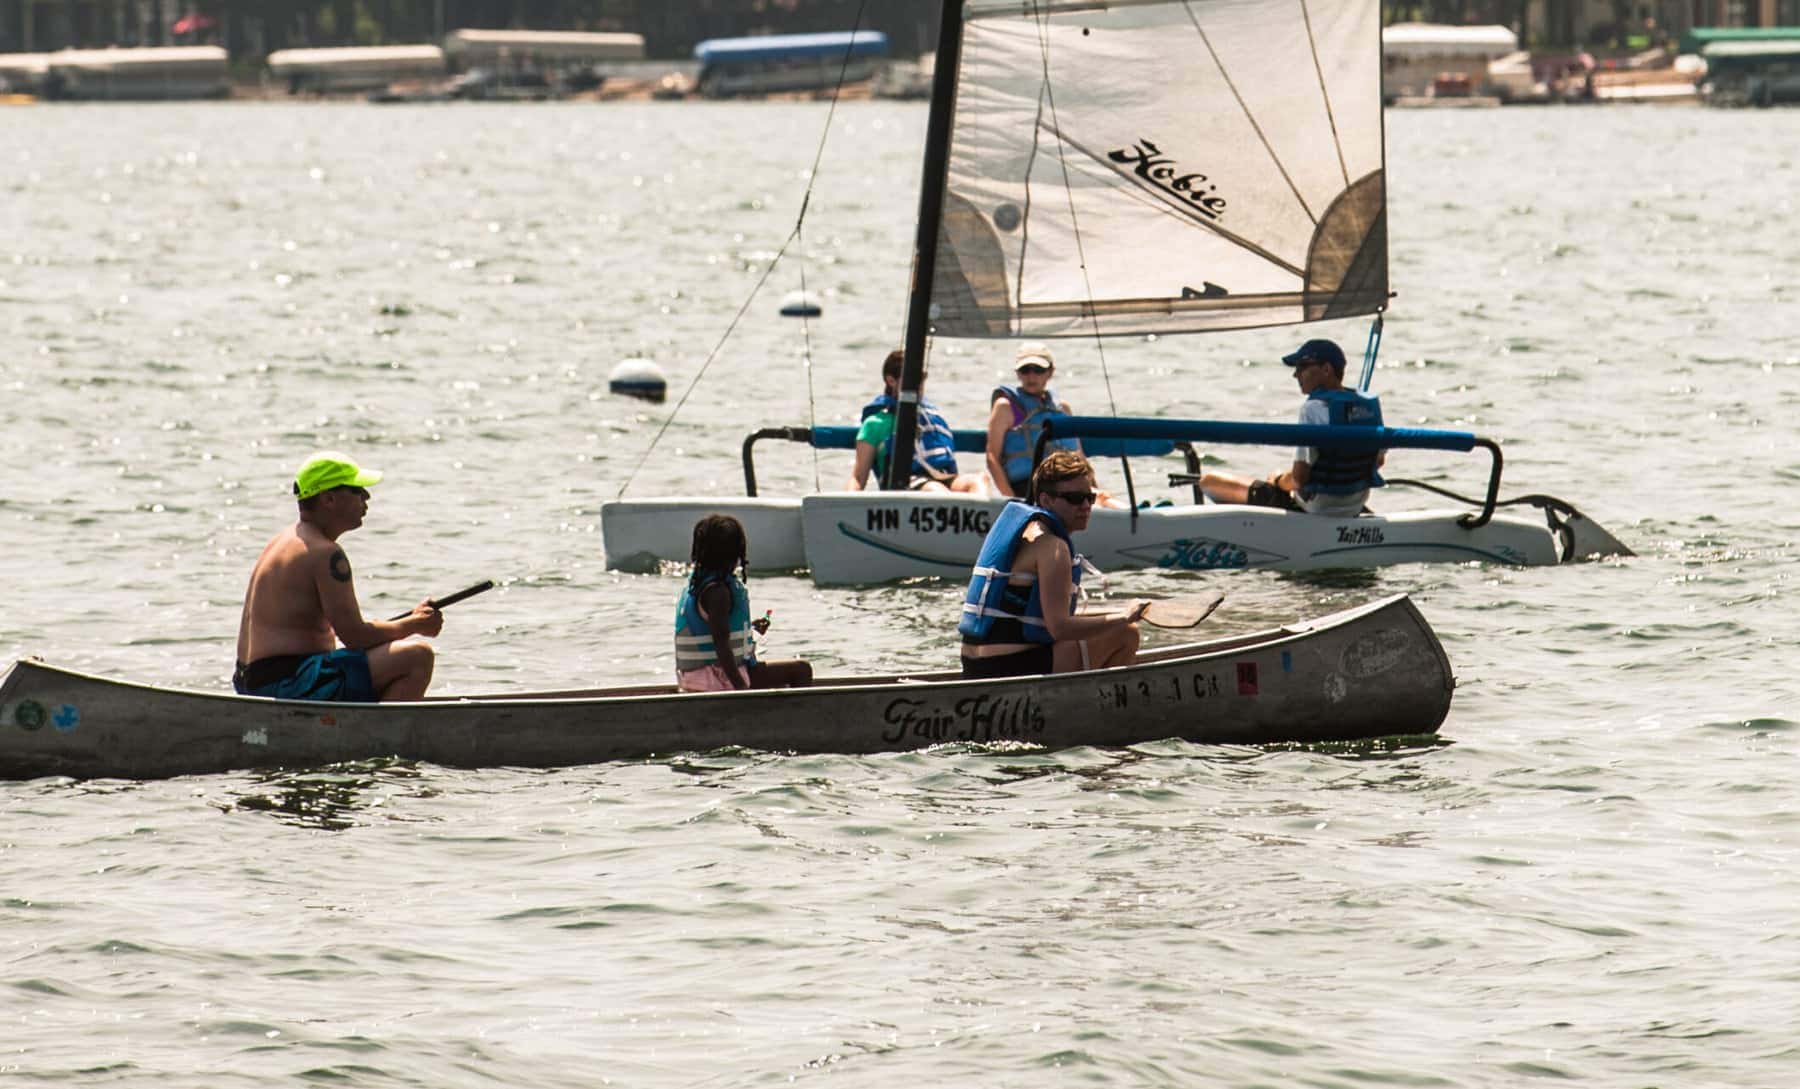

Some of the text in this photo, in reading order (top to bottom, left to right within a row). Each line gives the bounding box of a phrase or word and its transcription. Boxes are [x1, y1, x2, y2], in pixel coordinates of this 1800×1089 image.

[1108, 138, 1226, 219] Hobie
[867, 506, 990, 537] MN 4594KG
[1157, 538, 1249, 569] Hobie
[881, 693, 1046, 743] Fair Hills
